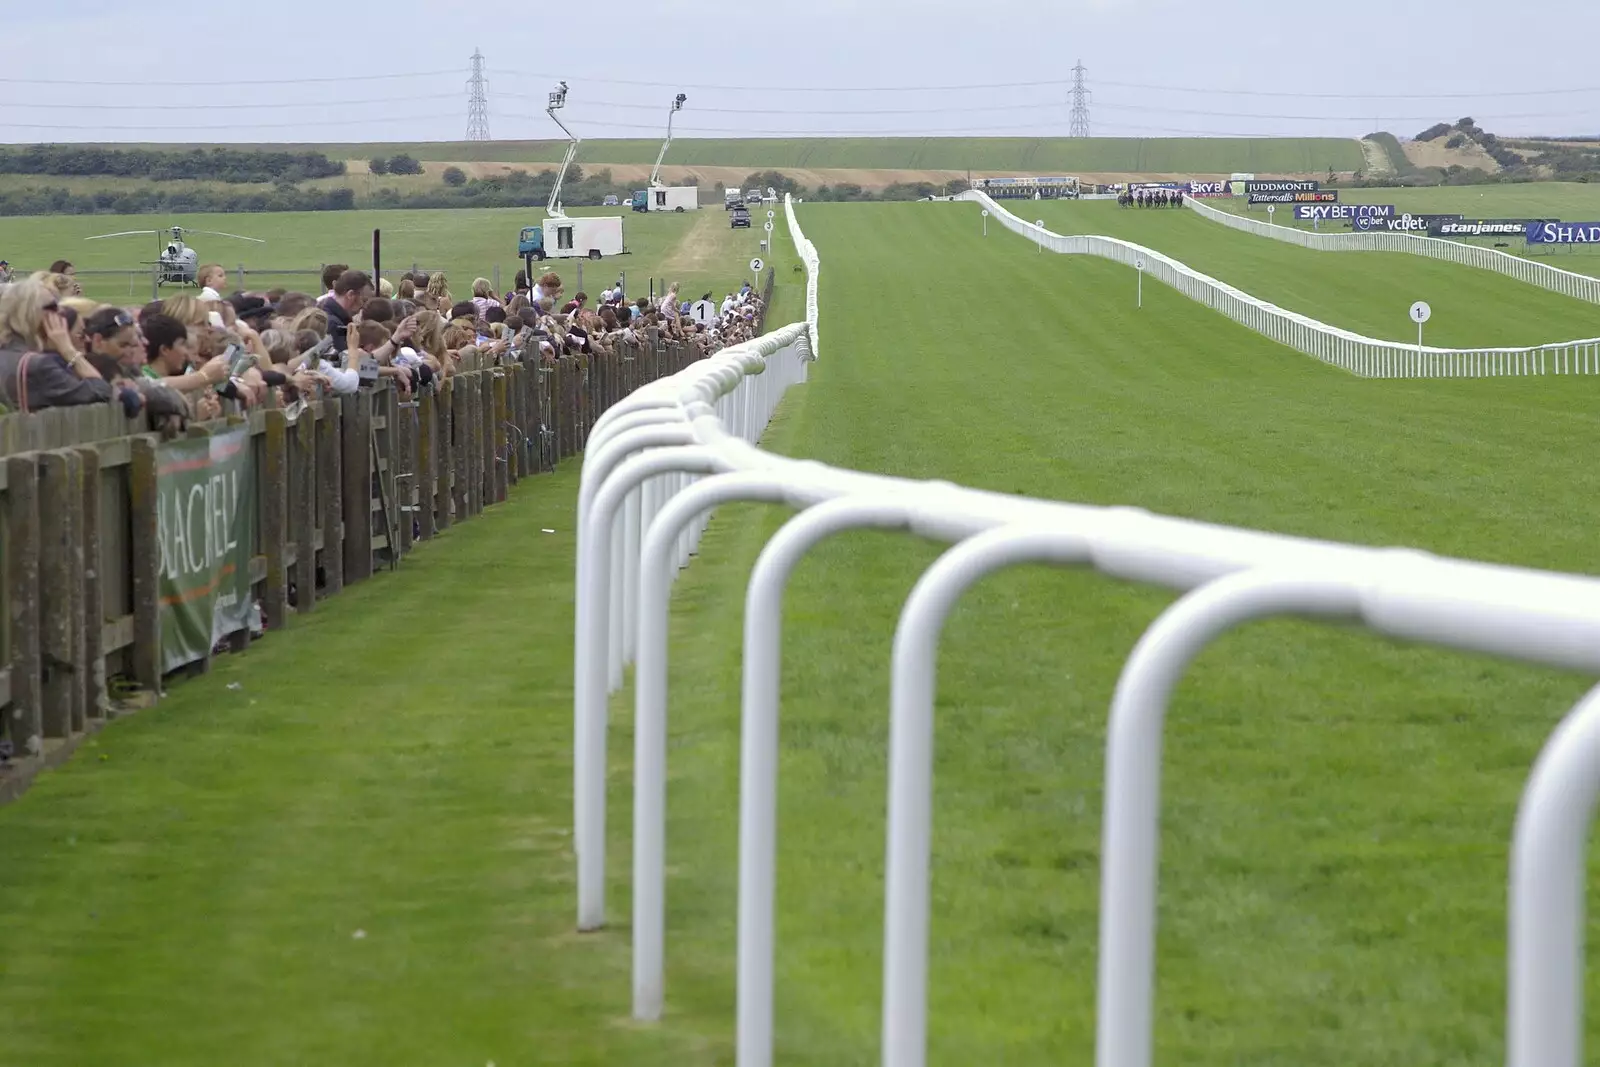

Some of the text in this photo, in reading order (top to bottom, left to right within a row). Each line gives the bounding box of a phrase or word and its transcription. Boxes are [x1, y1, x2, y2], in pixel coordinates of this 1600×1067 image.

[1249, 182, 1314, 192] JUDDMONTE
[1252, 192, 1334, 202] Tattersalls Millions
[1300, 206, 1388, 218] SKYBETCOM
[1387, 216, 1428, 230] vcbet.
[1441, 220, 1522, 234] stanjames
[754, 259, 760, 268] 2
[696, 303, 704, 320] 1
